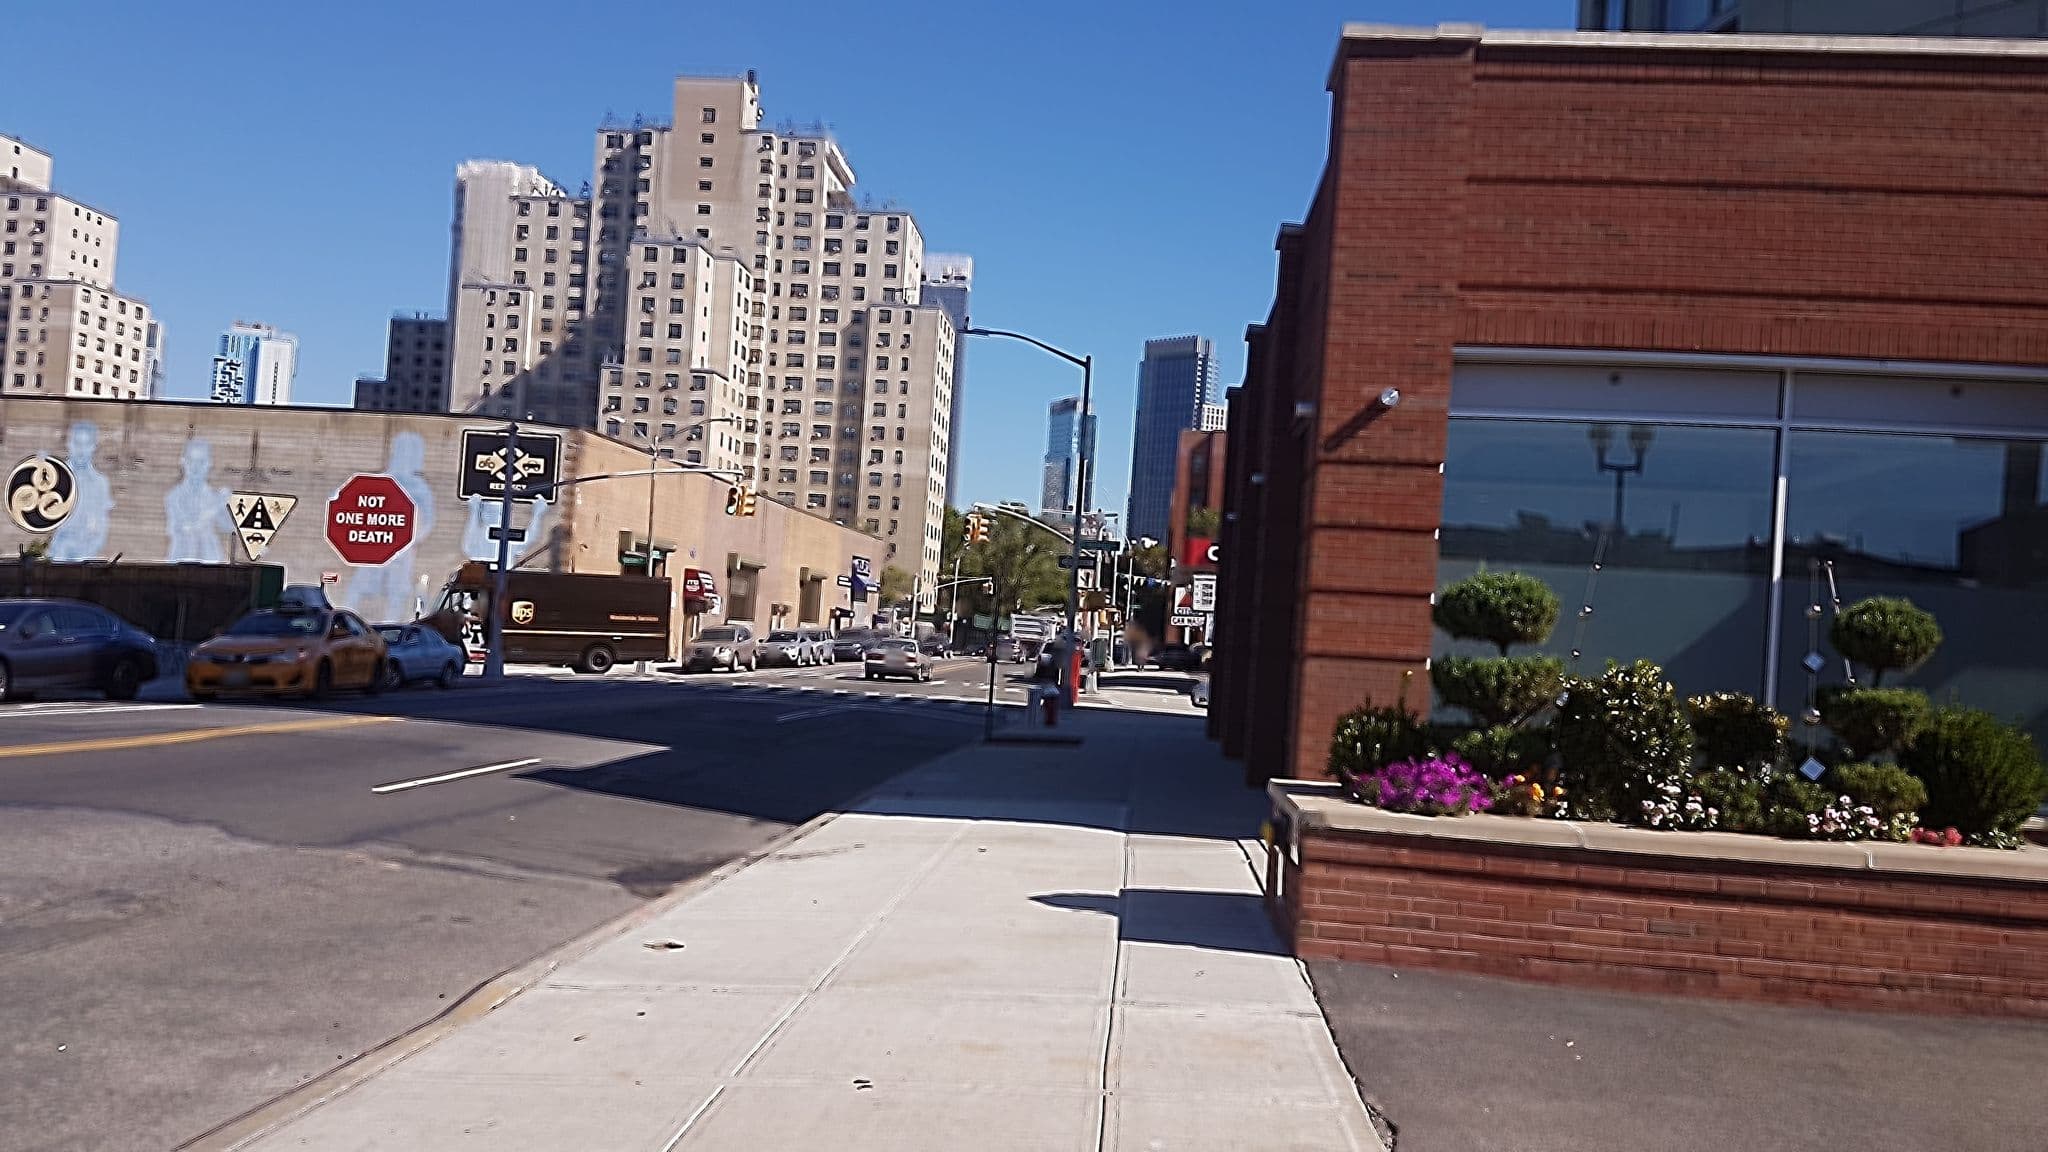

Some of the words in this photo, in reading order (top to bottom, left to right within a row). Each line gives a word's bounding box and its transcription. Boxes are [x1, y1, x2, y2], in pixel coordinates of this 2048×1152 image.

[358, 495, 386, 508] NOT
[335, 512, 364, 525] ONE
[367, 513, 406, 527] MORE
[348, 530, 394, 544] DEATH
